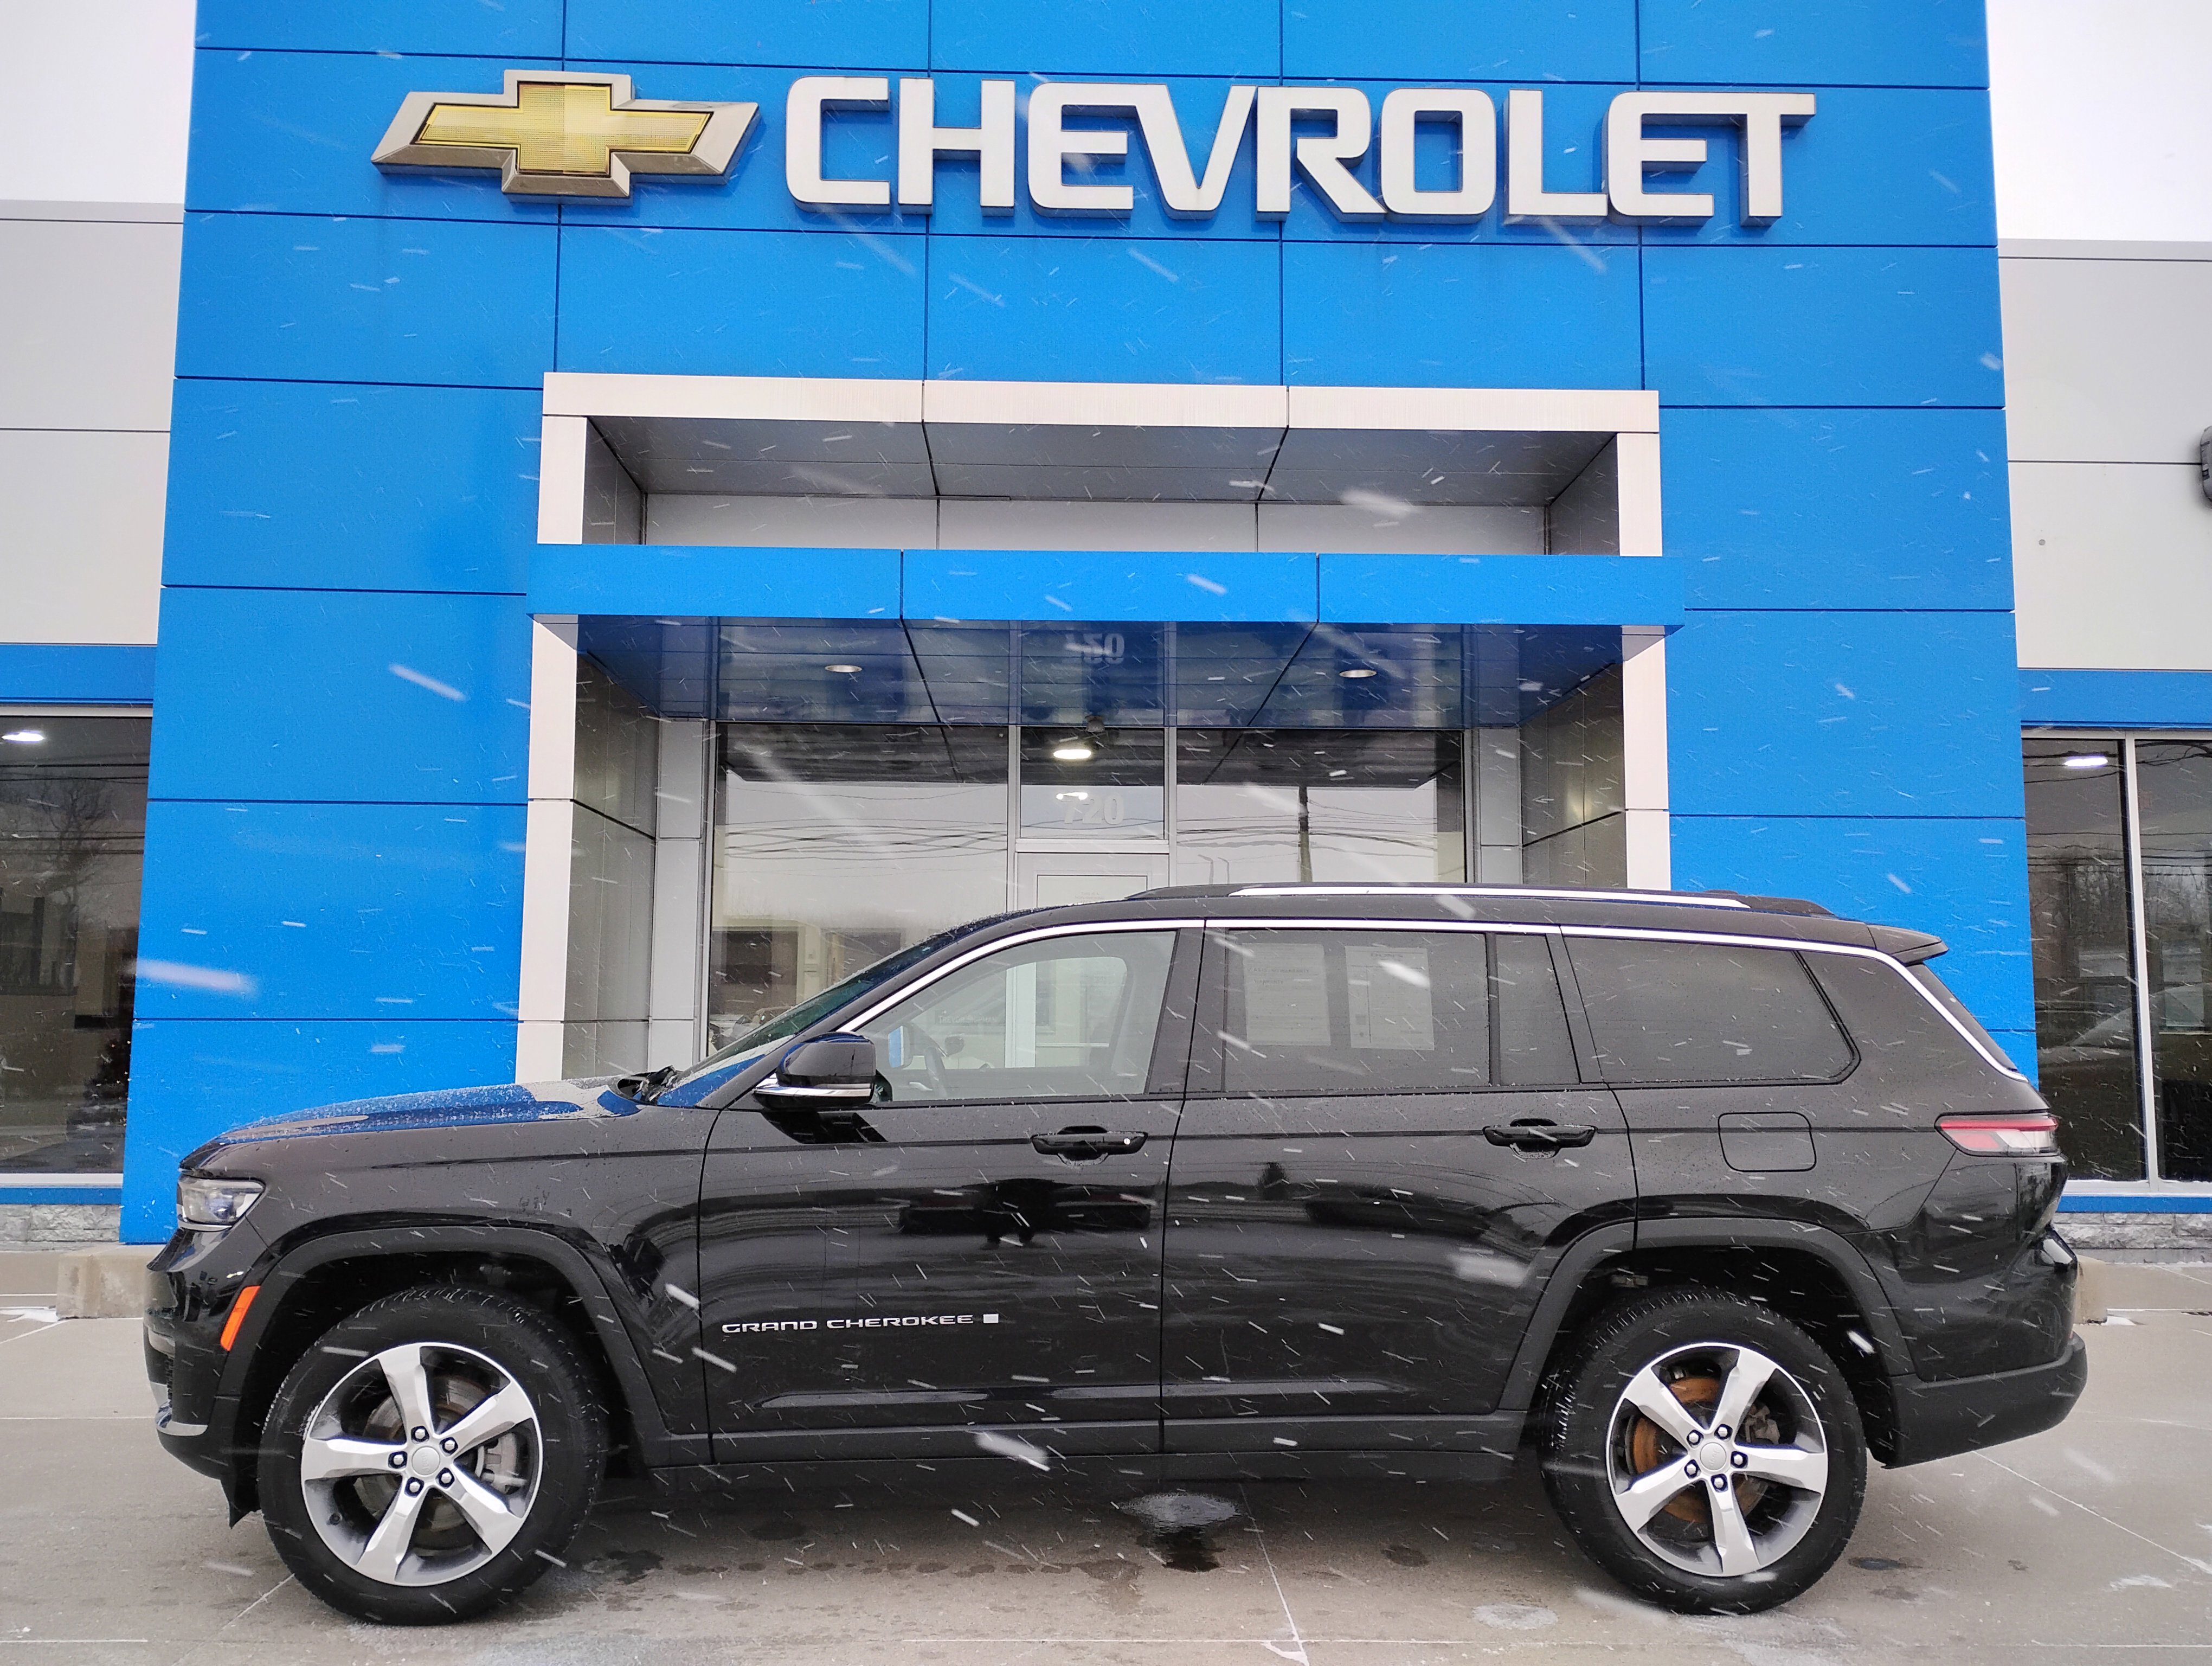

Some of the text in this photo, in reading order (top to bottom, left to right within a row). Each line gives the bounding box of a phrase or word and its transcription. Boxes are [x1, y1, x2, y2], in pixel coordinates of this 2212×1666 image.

[785, 76, 1816, 219] CHEVROLET
[722, 1321, 818, 1333] GRAND
[826, 1315, 974, 1329] CHEROKEE
